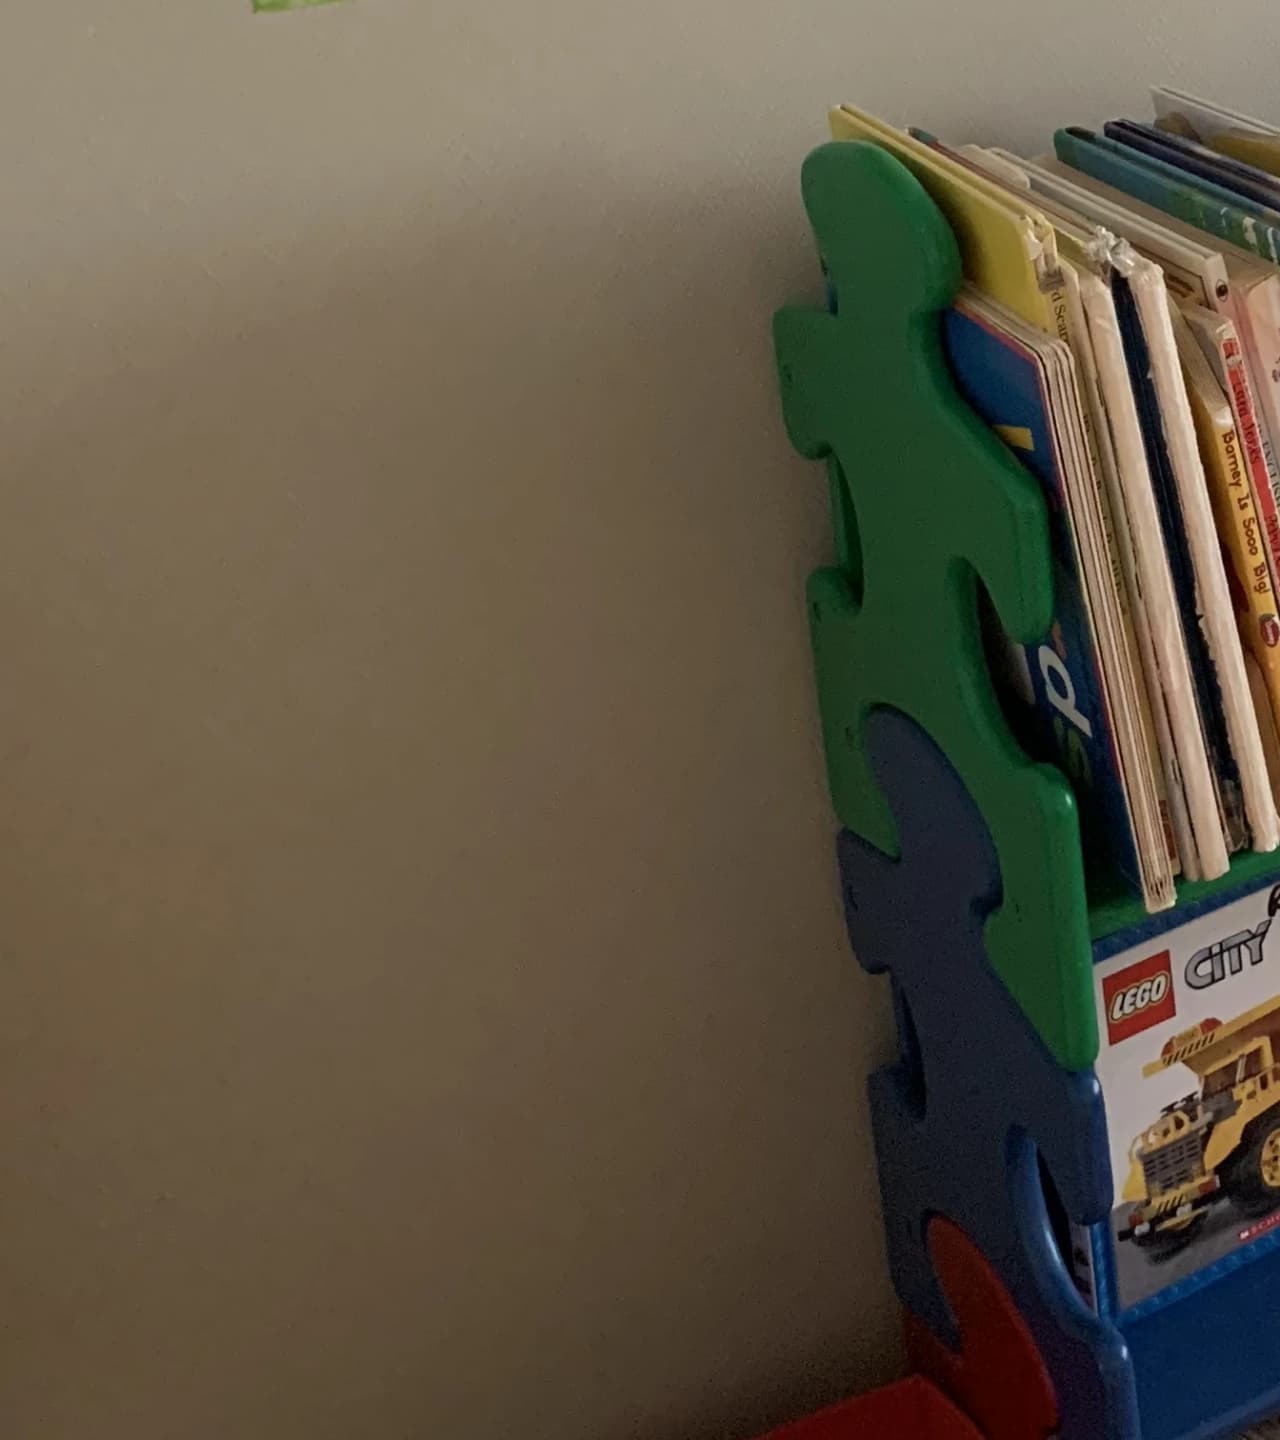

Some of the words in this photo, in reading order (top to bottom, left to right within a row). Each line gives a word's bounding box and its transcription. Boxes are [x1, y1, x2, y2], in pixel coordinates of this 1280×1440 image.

[1221, 430, 1245, 489] Barney
[1236, 494, 1251, 510] Is
[1242, 519, 1259, 556] Sooo
[1252, 563, 1270, 594] Big!
[1184, 918, 1272, 989] CITY
[1110, 973, 1169, 1023] LEGO
